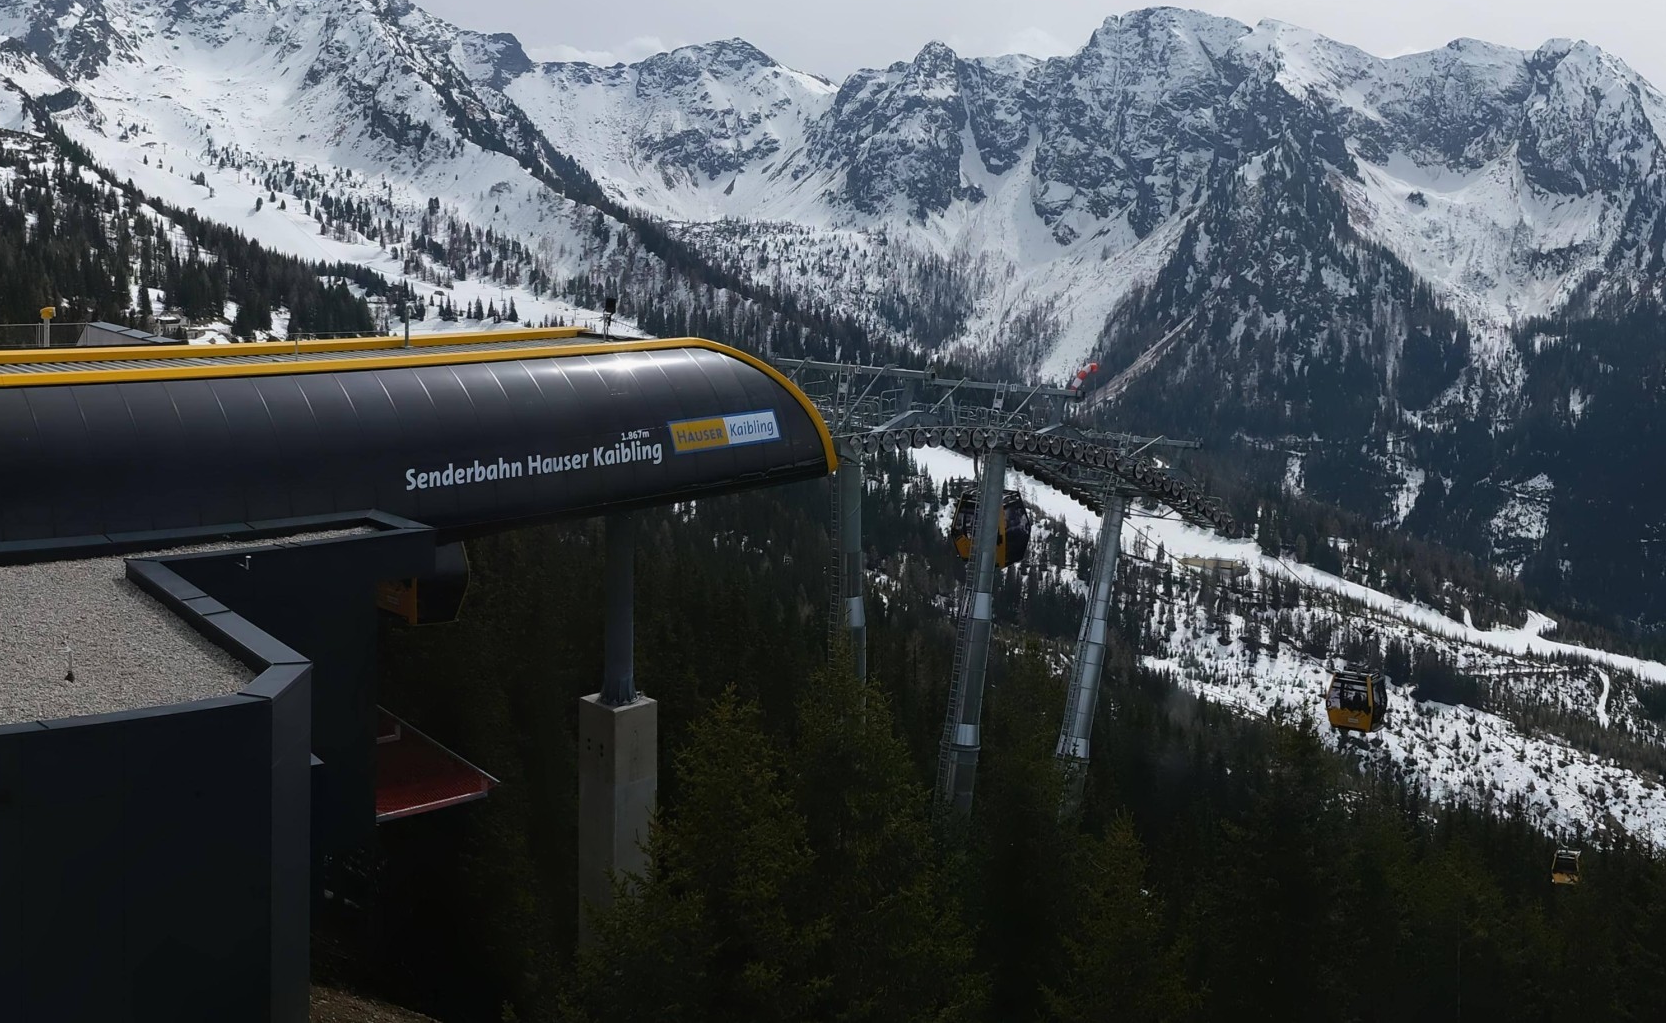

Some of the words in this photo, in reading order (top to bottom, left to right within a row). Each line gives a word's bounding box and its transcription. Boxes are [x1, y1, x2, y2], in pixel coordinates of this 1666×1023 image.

[621, 429, 650, 441] 1.867m
[677, 427, 724, 445] HAUSER
[729, 419, 774, 439] Kaibling
[405, 457, 523, 491] Senderbahn
[527, 452, 589, 477] Hauser
[593, 440, 663, 465] Kaibling
